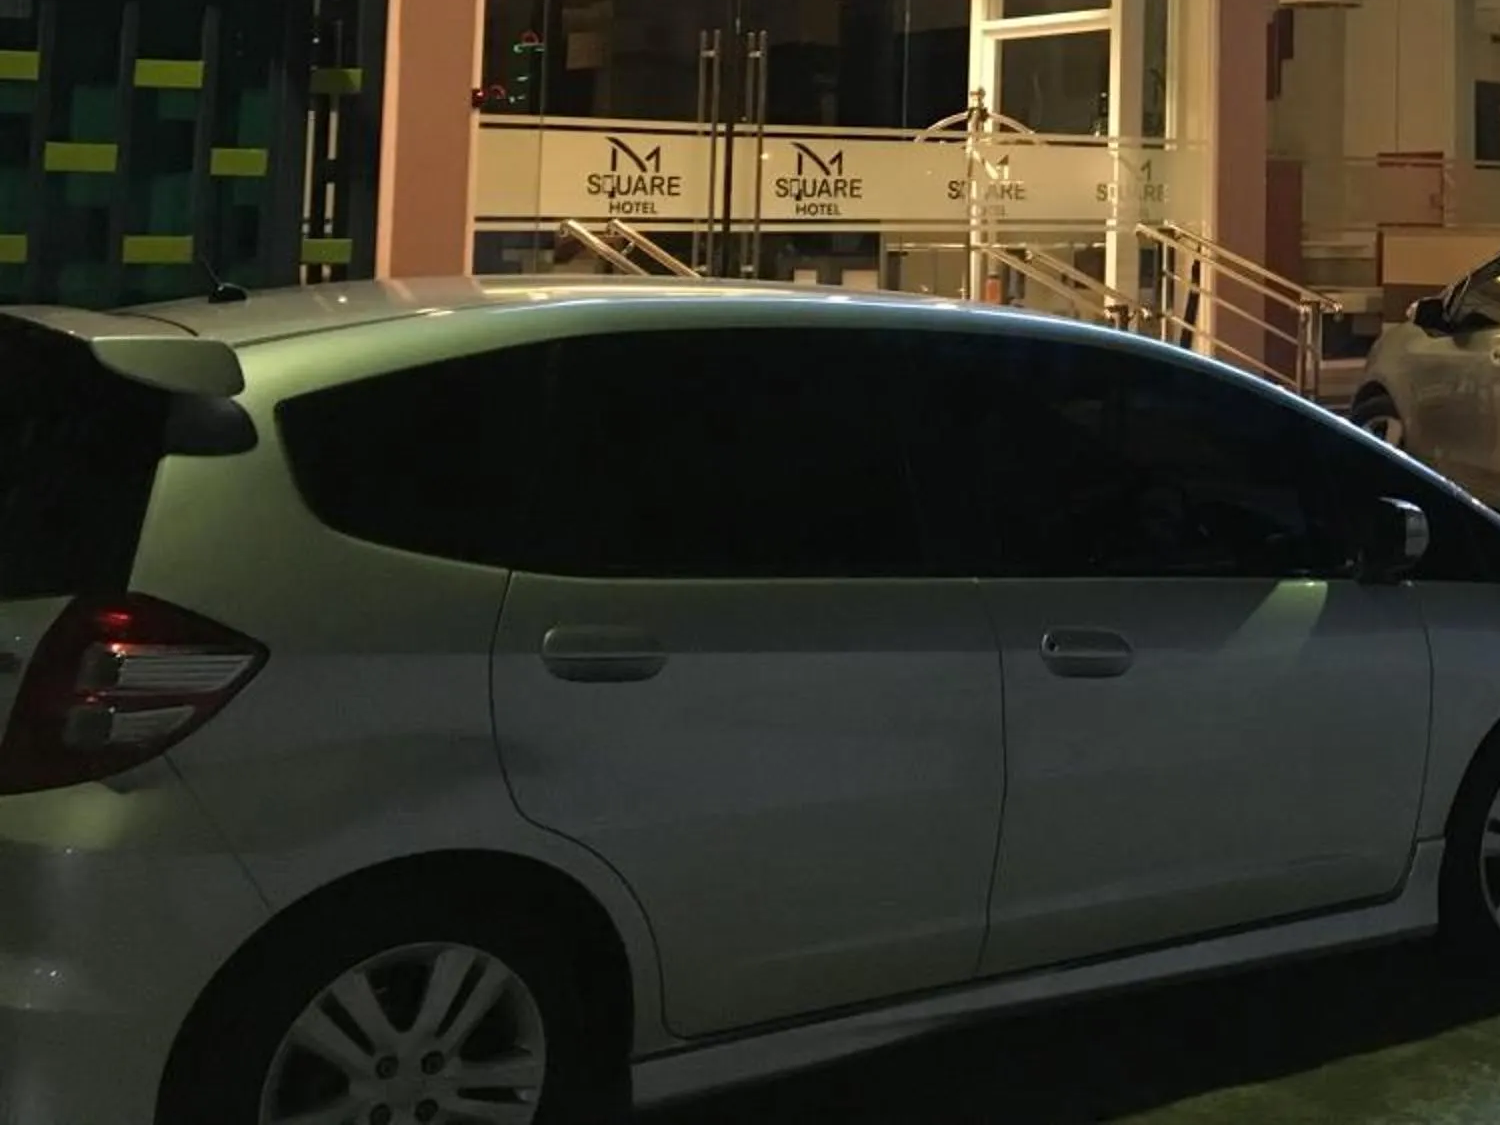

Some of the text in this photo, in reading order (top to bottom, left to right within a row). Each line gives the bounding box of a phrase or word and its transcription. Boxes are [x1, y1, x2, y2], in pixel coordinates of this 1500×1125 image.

[605, 136, 660, 173] M
[791, 141, 843, 176] M
[587, 174, 682, 198] SQUARE
[775, 178, 863, 201] SQUARE
[608, 201, 657, 215] HOTEL
[795, 202, 842, 216] HOTEL
